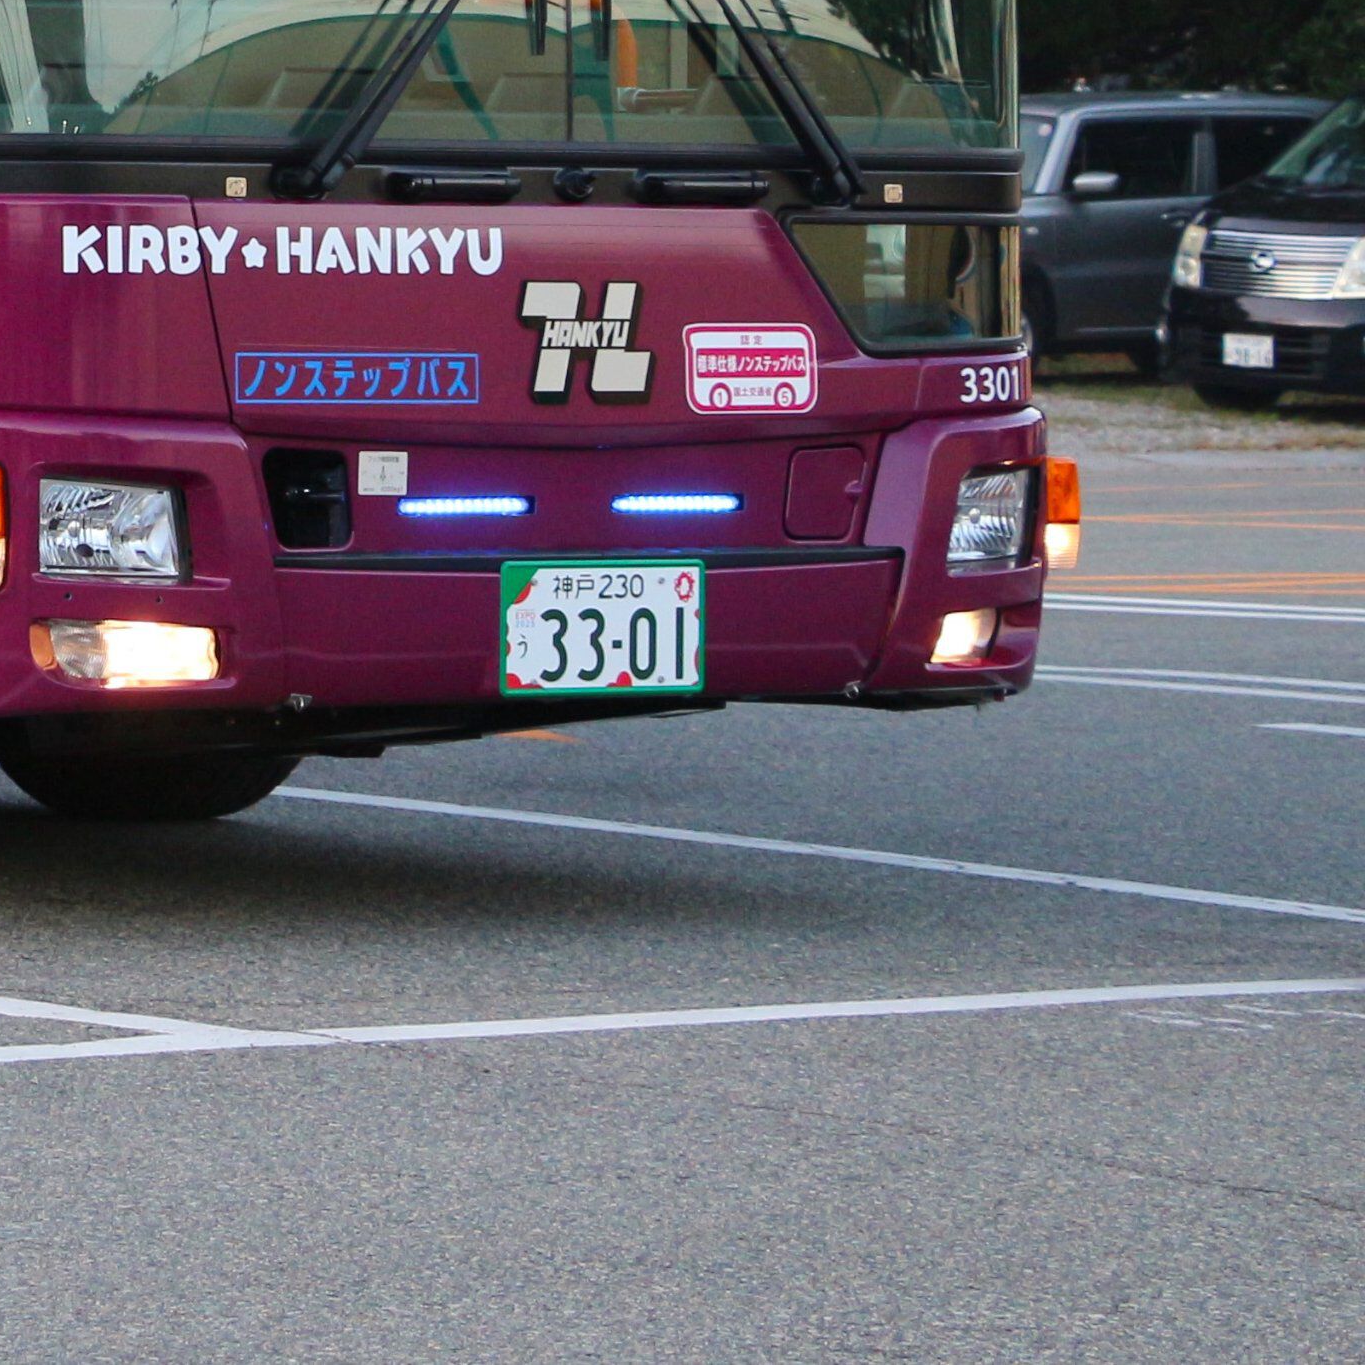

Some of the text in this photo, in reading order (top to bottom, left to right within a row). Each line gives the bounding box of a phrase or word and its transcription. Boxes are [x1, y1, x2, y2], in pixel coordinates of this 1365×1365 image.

[61, 224, 503, 275] KIRBY HANKYU
[541, 320, 631, 347] HANKYU
[244, 358, 469, 398] ノンステップバス
[960, 366, 1020, 403] 3301
[539, 607, 685, 683] 33-01
